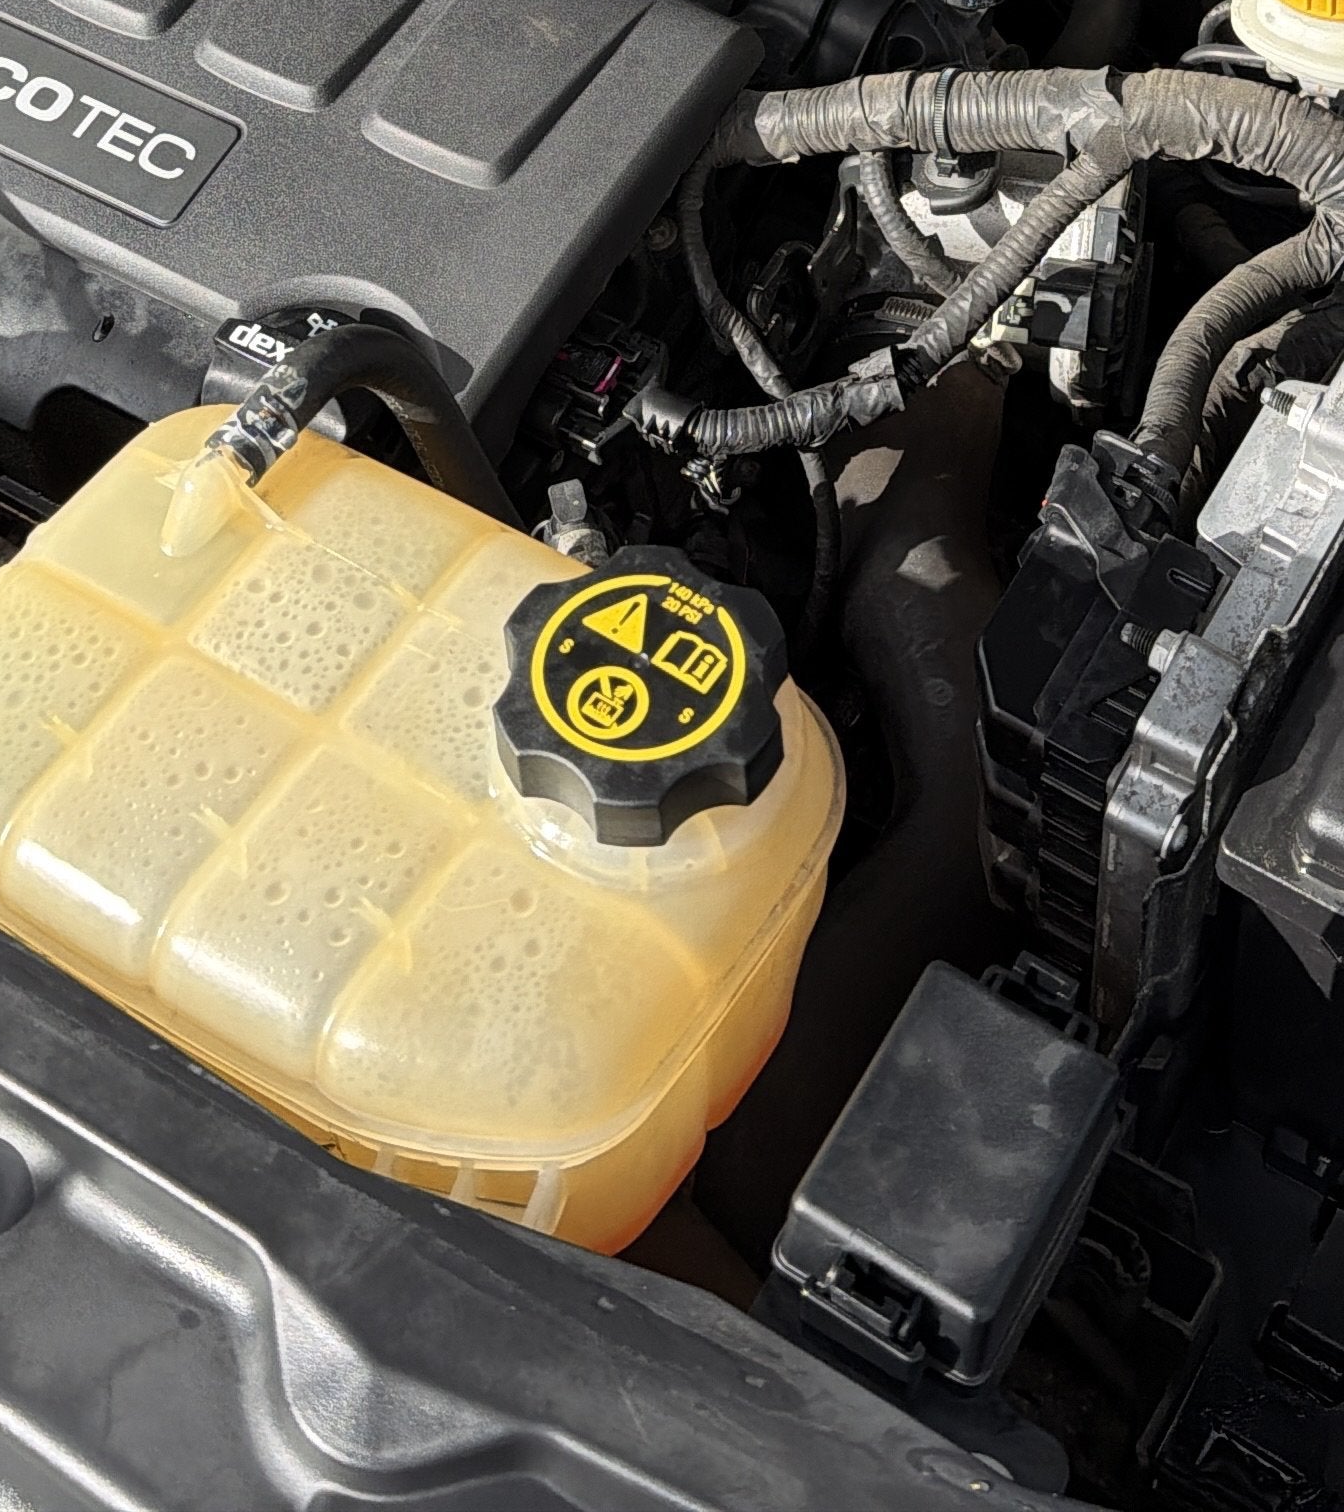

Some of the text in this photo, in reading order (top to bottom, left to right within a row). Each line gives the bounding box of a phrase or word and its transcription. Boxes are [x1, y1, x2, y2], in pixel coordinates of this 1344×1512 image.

[229, 324, 294, 362] dex
[661, 596, 703, 625] 20 PSI
[668, 582, 715, 616] 140 kPa
